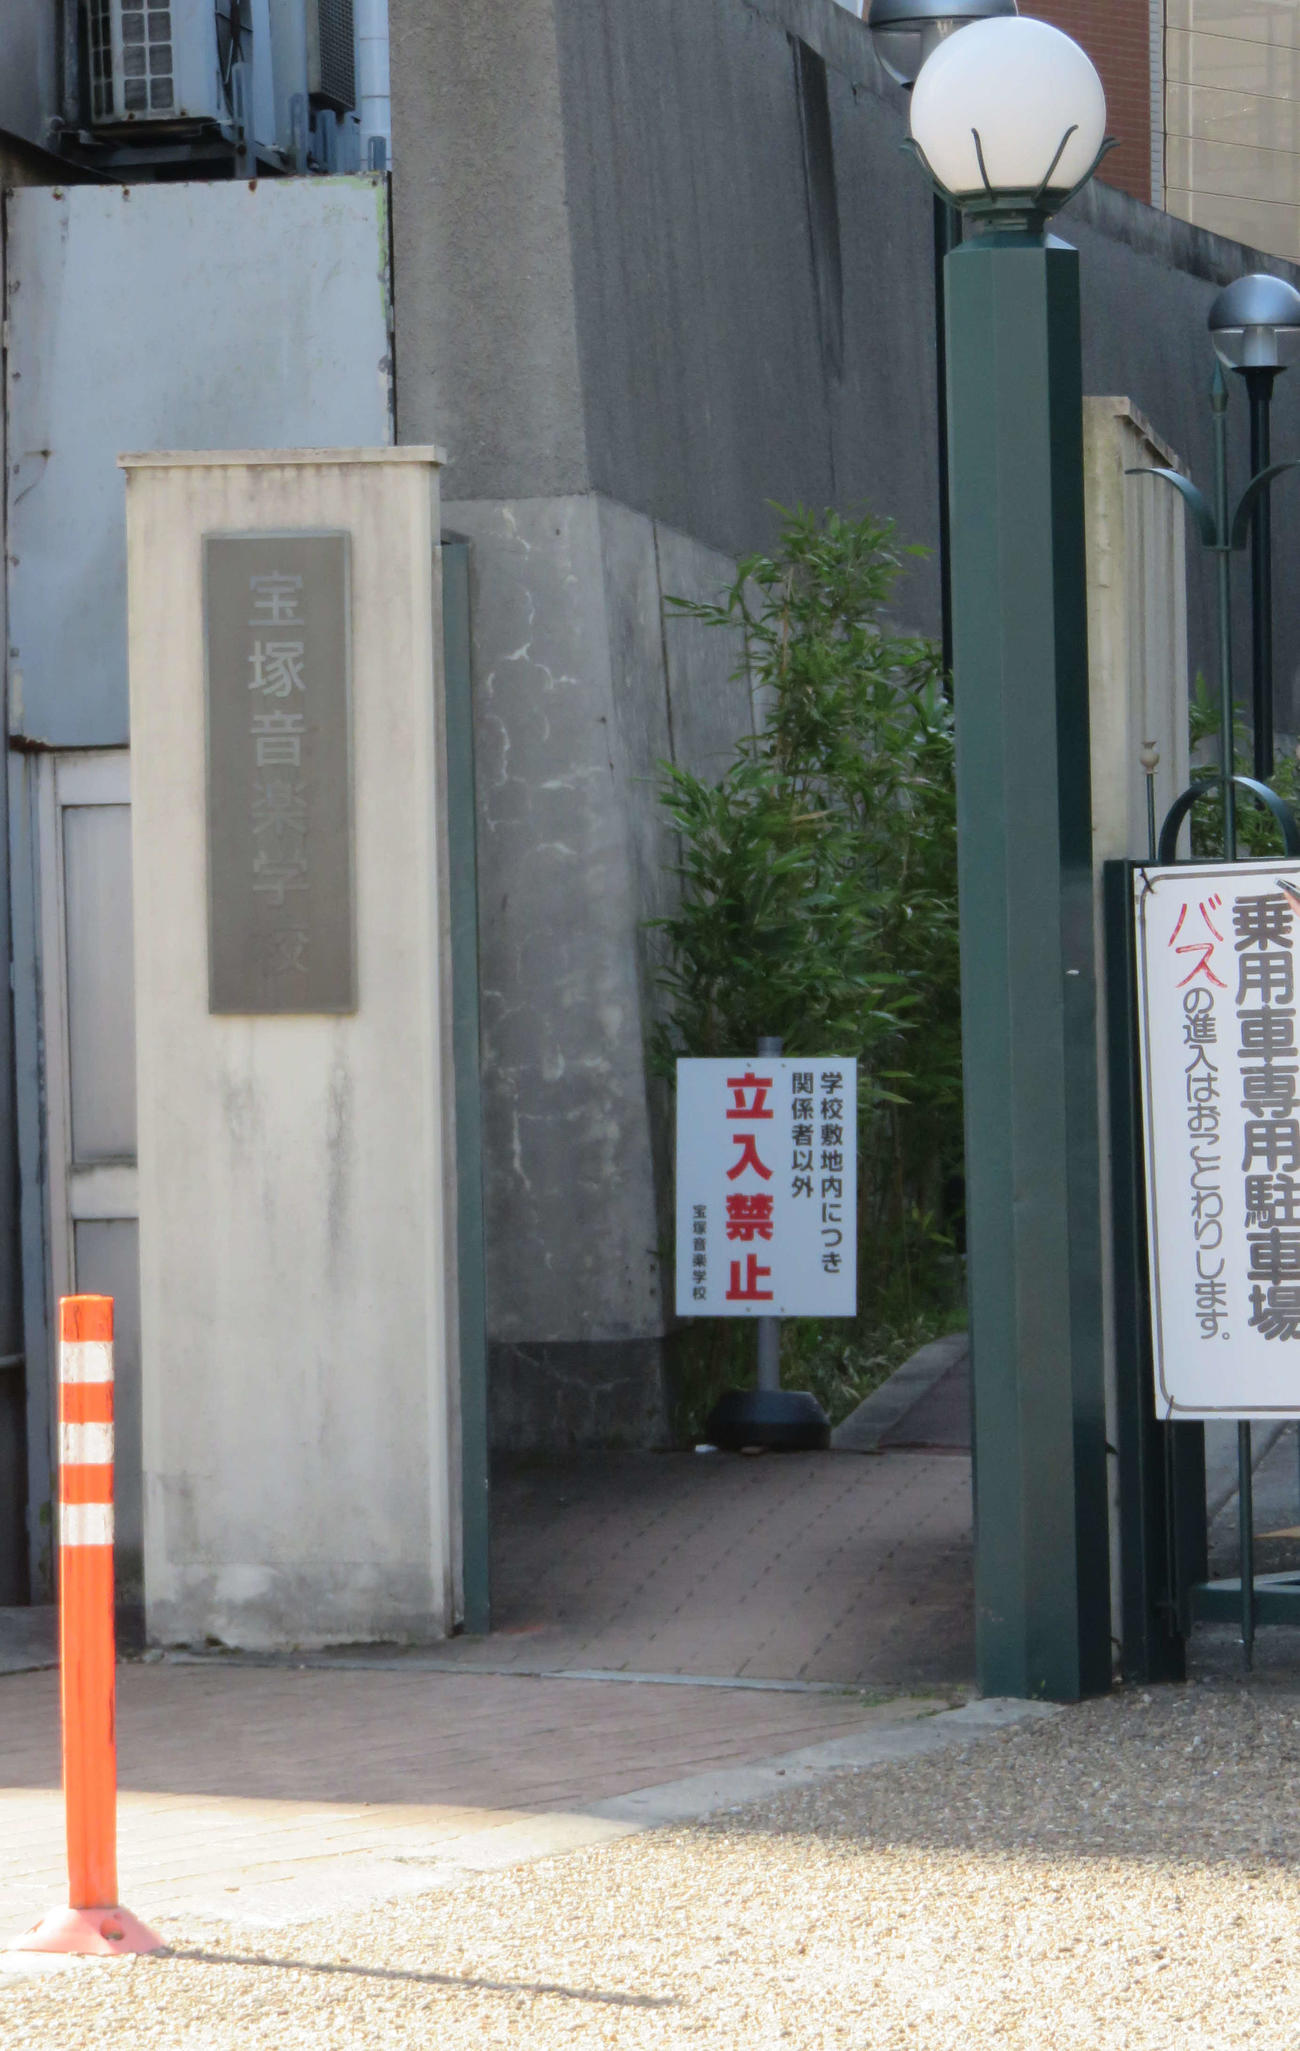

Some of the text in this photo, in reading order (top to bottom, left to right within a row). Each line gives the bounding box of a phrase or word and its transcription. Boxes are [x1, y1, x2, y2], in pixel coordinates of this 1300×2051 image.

[726, 1072, 774, 1300] 立入禁止
[791, 1072, 814, 1199] 関係者以外
[820, 1072, 843, 1274] 学校敷地内につき
[1168, 893, 1230, 1340] バスの進入はおことわりします。
[1232, 892, 1300, 1342] 乗用車専用駐車場
[693, 1204, 707, 1300] 宝塚音楽学校
